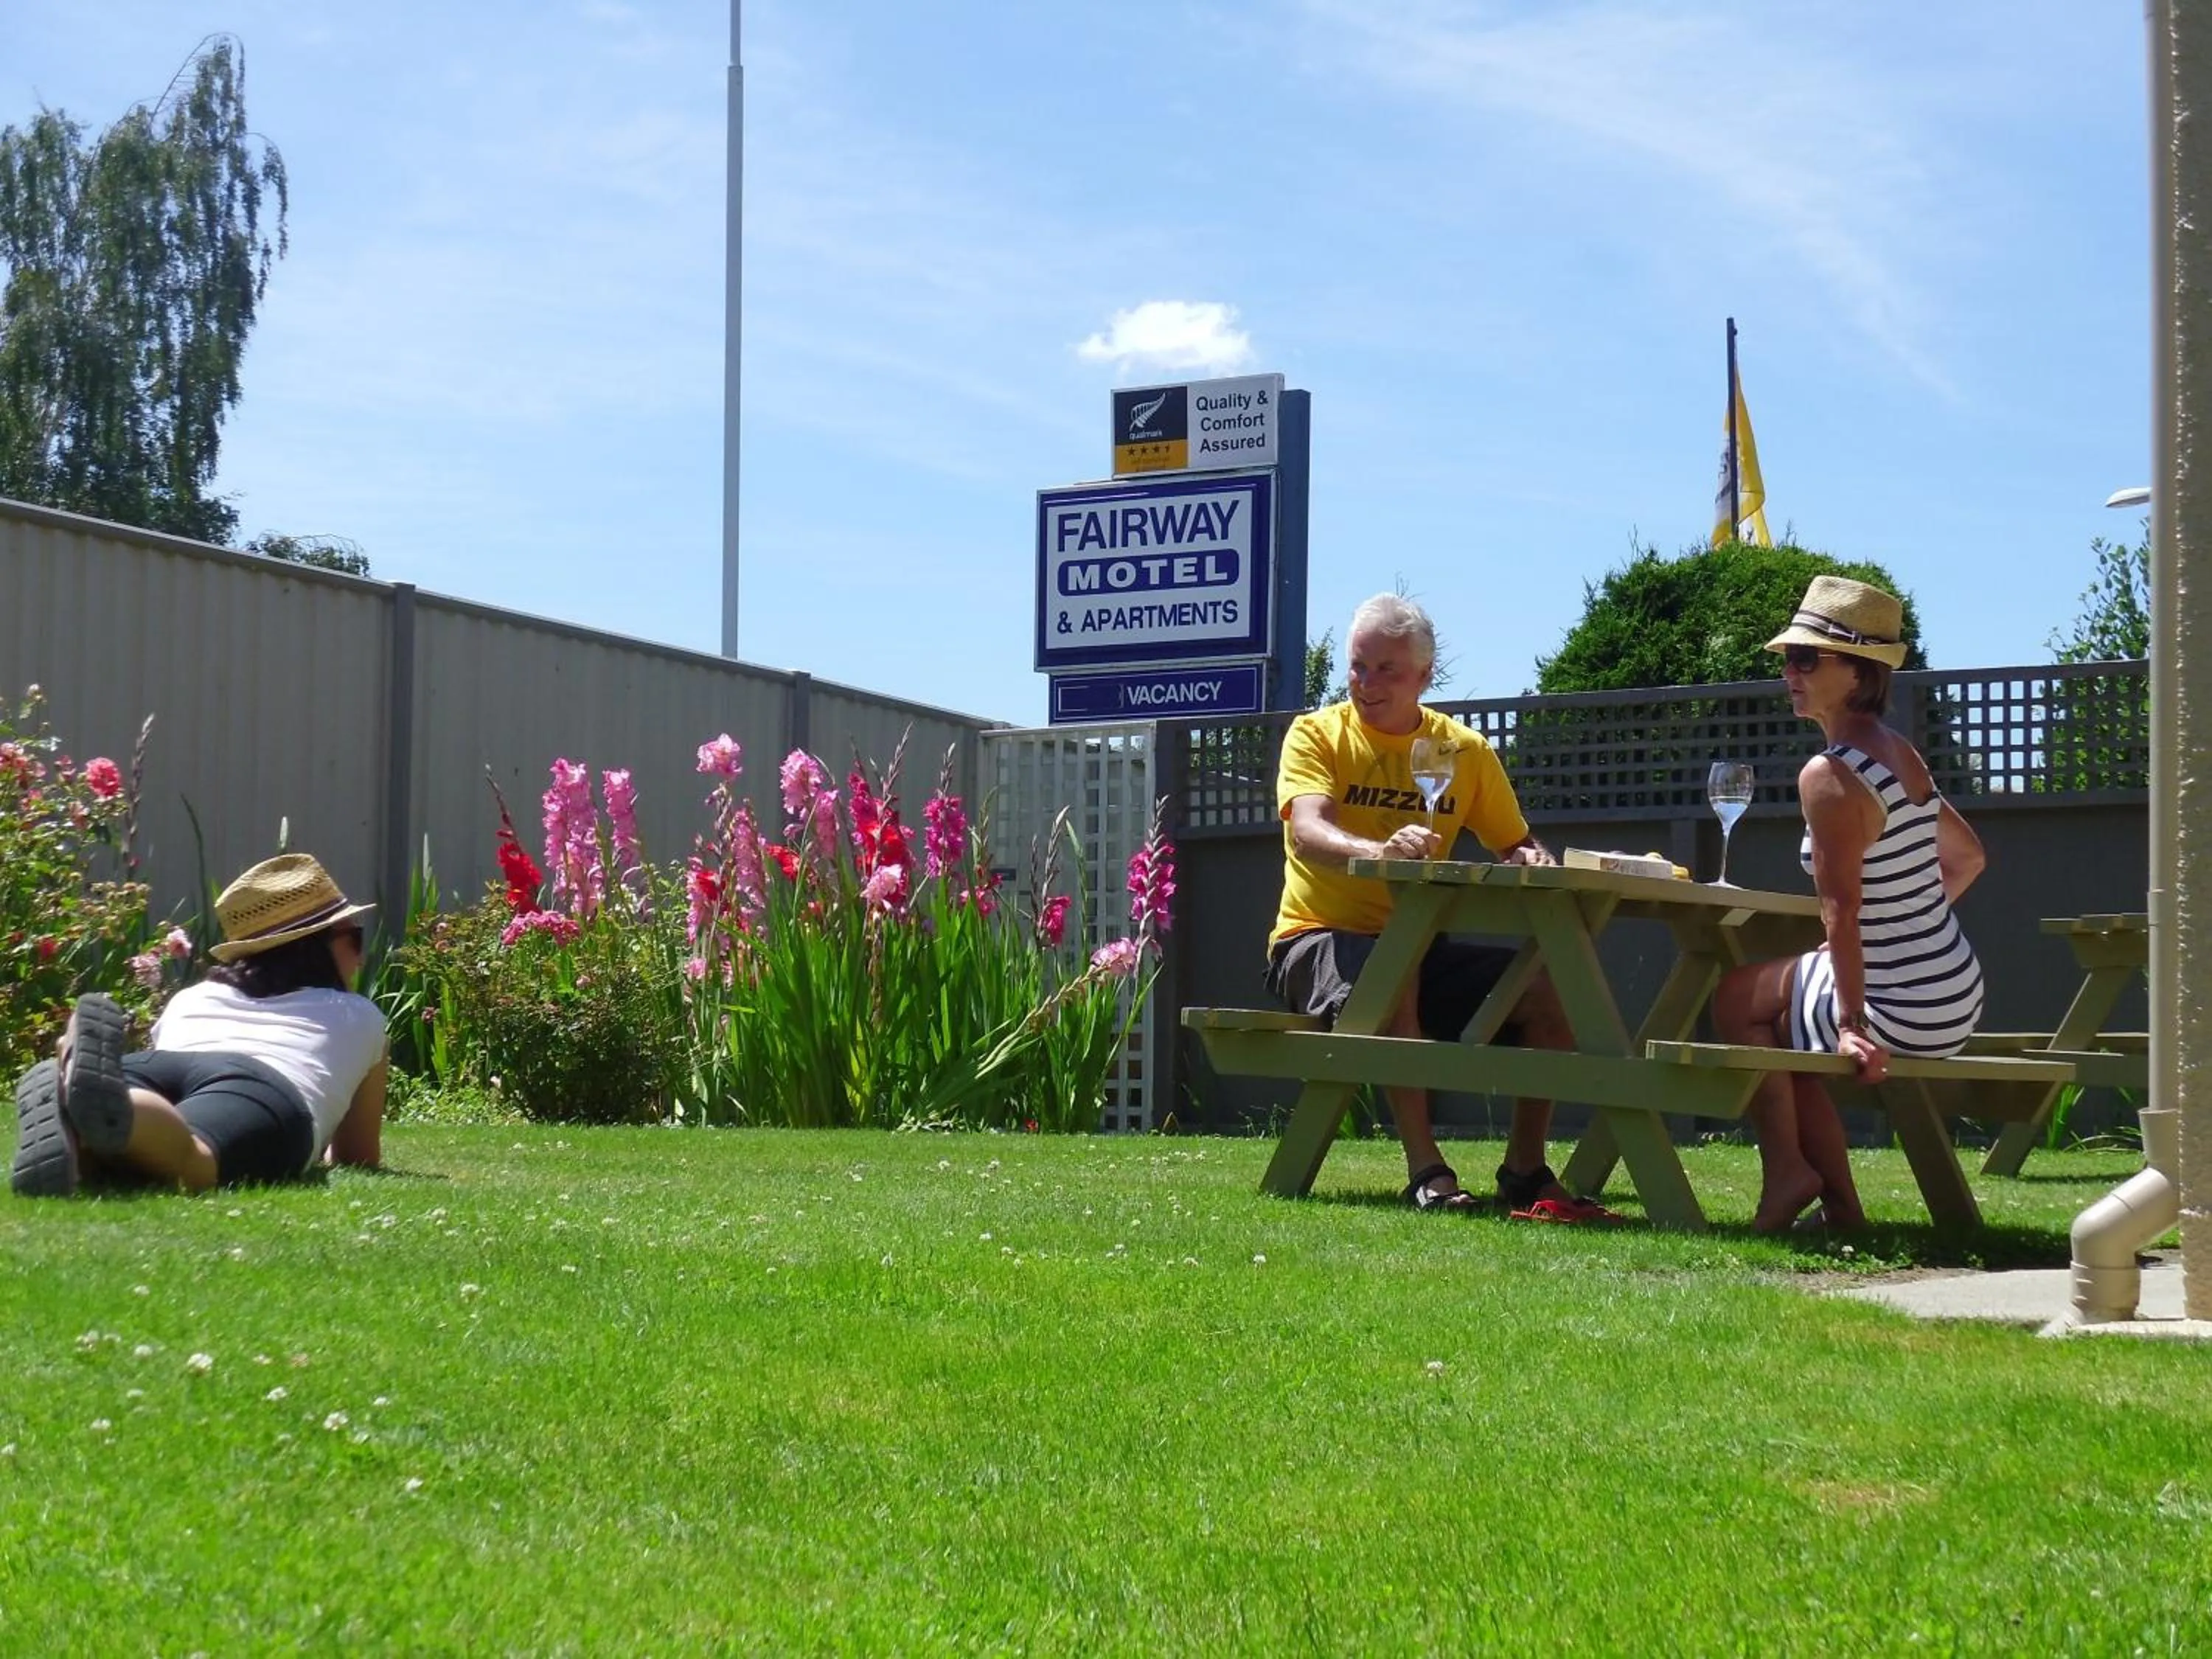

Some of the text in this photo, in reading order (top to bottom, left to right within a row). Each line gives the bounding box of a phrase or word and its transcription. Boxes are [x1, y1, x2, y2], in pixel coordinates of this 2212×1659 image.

[1197, 390, 1268, 411] Quality &
[1200, 413, 1265, 431] Comfort
[1200, 433, 1265, 453] Assured
[1057, 500, 1239, 552] FAIRWAY
[1068, 555, 1228, 591] MOTEL
[1057, 599, 1238, 633] & APARTMENTS
[1127, 681, 1222, 706] VACANCY
